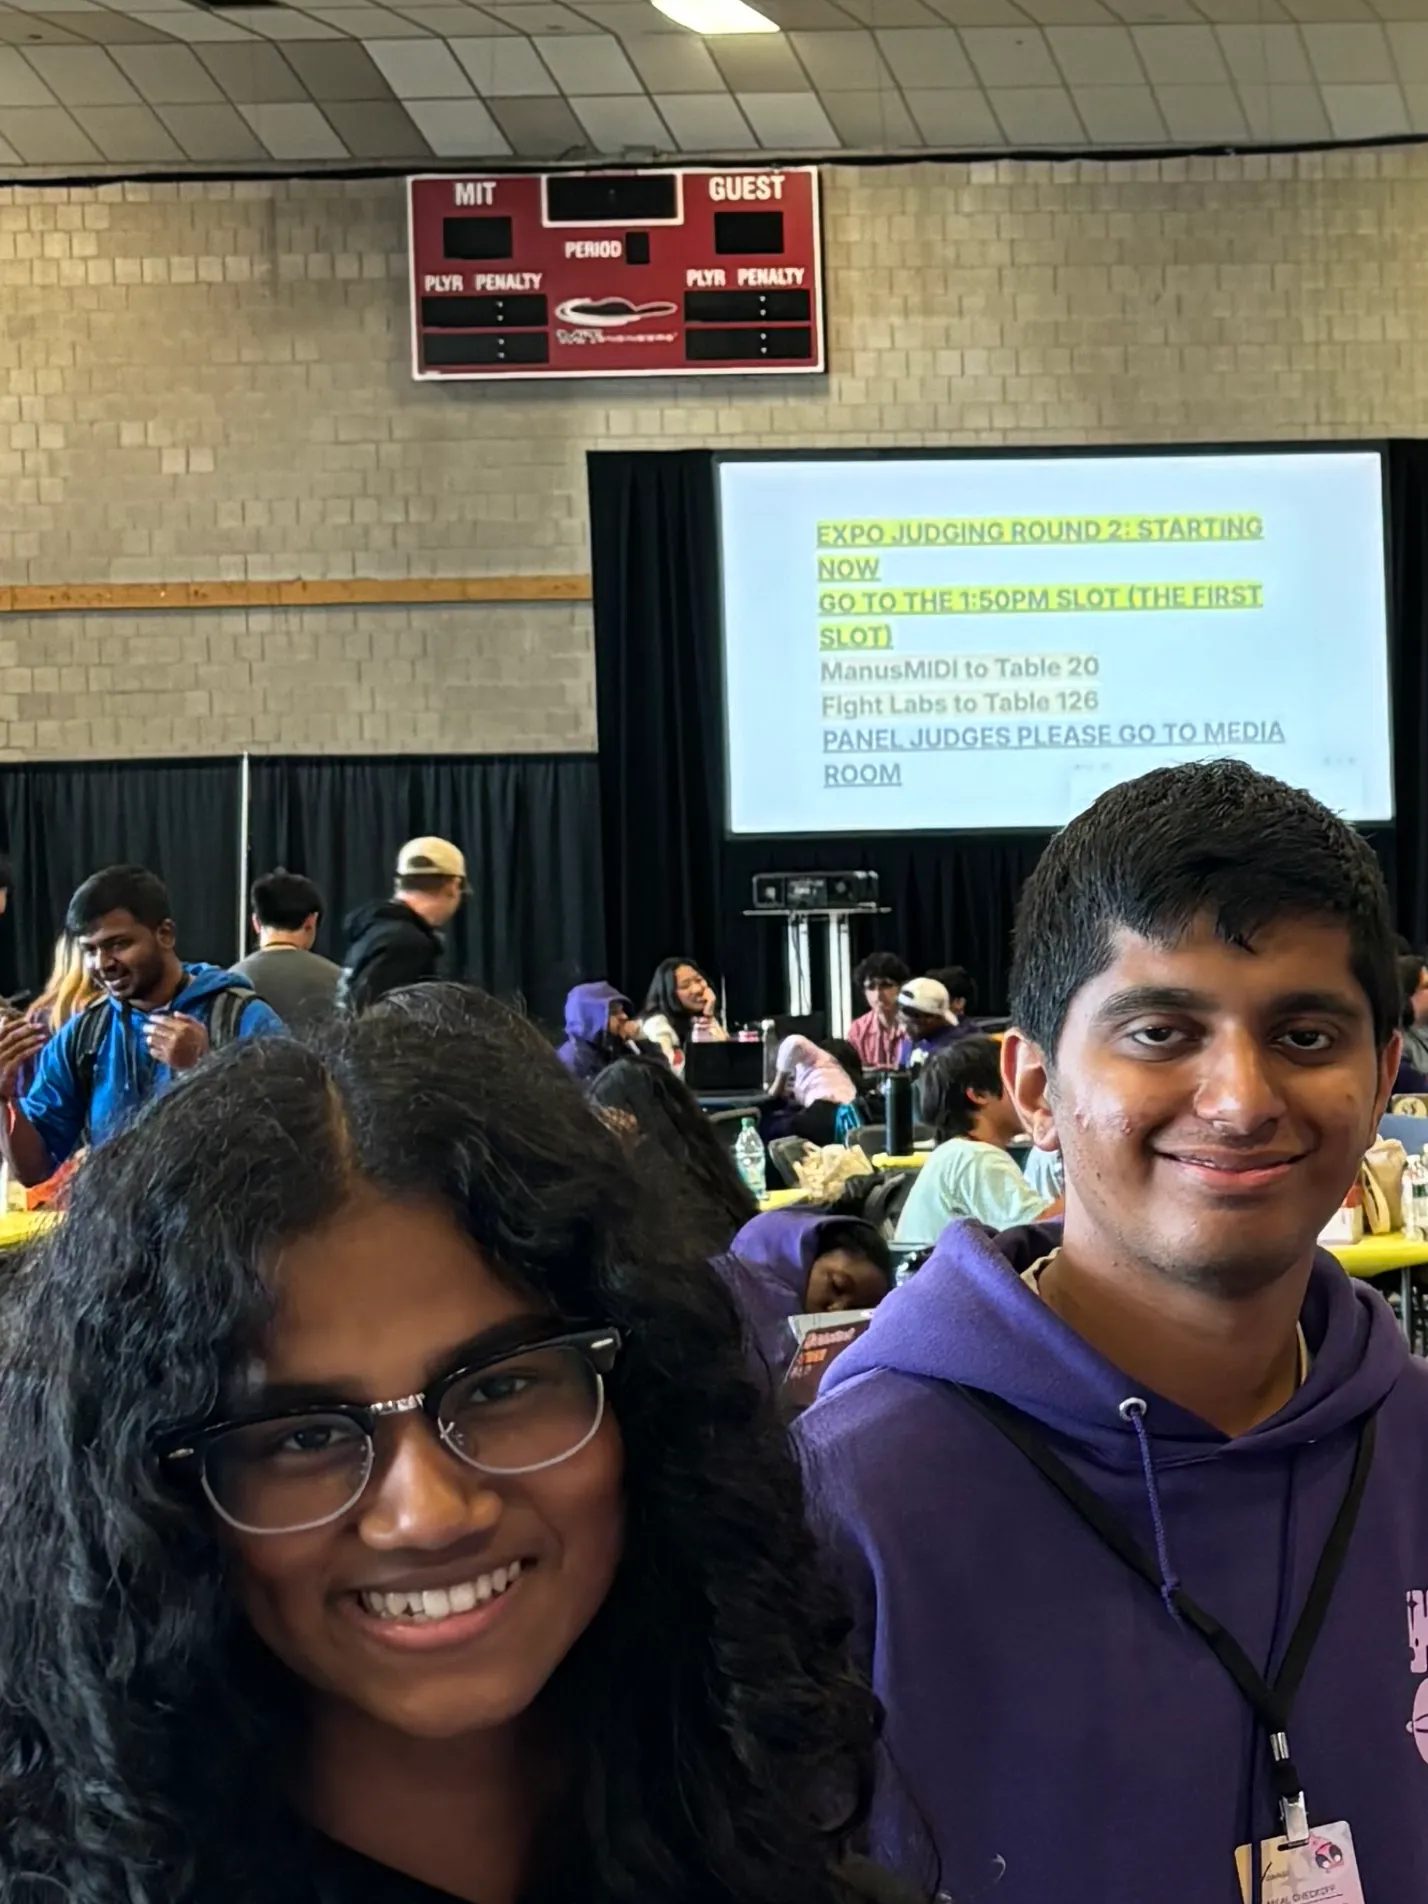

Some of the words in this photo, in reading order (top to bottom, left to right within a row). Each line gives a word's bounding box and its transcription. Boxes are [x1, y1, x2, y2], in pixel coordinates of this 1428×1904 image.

[454, 182, 497, 207] MIT
[709, 176, 786, 202] GUEST
[564, 241, 622, 259] PERIOD
[424, 273, 464, 292] PLYR
[475, 272, 543, 292] PENALTY
[686, 268, 726, 287] PLYR
[737, 267, 805, 286] PENALTY
[817, 524, 885, 546] EXPO
[892, 522, 1005, 545] JUDGING
[1012, 520, 1101, 543] ROUND
[1108, 520, 1131, 541] 2:
[1138, 517, 1264, 541] STARTING
[818, 558, 880, 580] NOW
[819, 593, 856, 613] GO
[862, 592, 897, 612] TO
[903, 591, 953, 612] THE
[959, 588, 1049, 611] 1:50PM
[1056, 587, 1120, 609] SLOT
[1127, 585, 1191, 608] (THE
[1193, 584, 1263, 608] FIRST
[820, 623, 894, 647] SLOT)
[820, 660, 959, 682] ManusMIDI
[964, 661, 988, 679] to
[995, 658, 1061, 679] Table
[1067, 656, 1100, 677] 20
[890, 695, 948, 715] Labs
[954, 694, 978, 714] to
[984, 692, 1050, 713] Table
[1058, 691, 1100, 712] 126
[823, 728, 904, 751] PANEL
[909, 727, 1011, 749] JUDGES
[1018, 724, 1111, 748] PLEASE
[1118, 724, 1156, 745] GO
[1163, 723, 1197, 744] TO
[1204, 721, 1286, 744] MEDIA
[824, 763, 902, 786] ROOM
